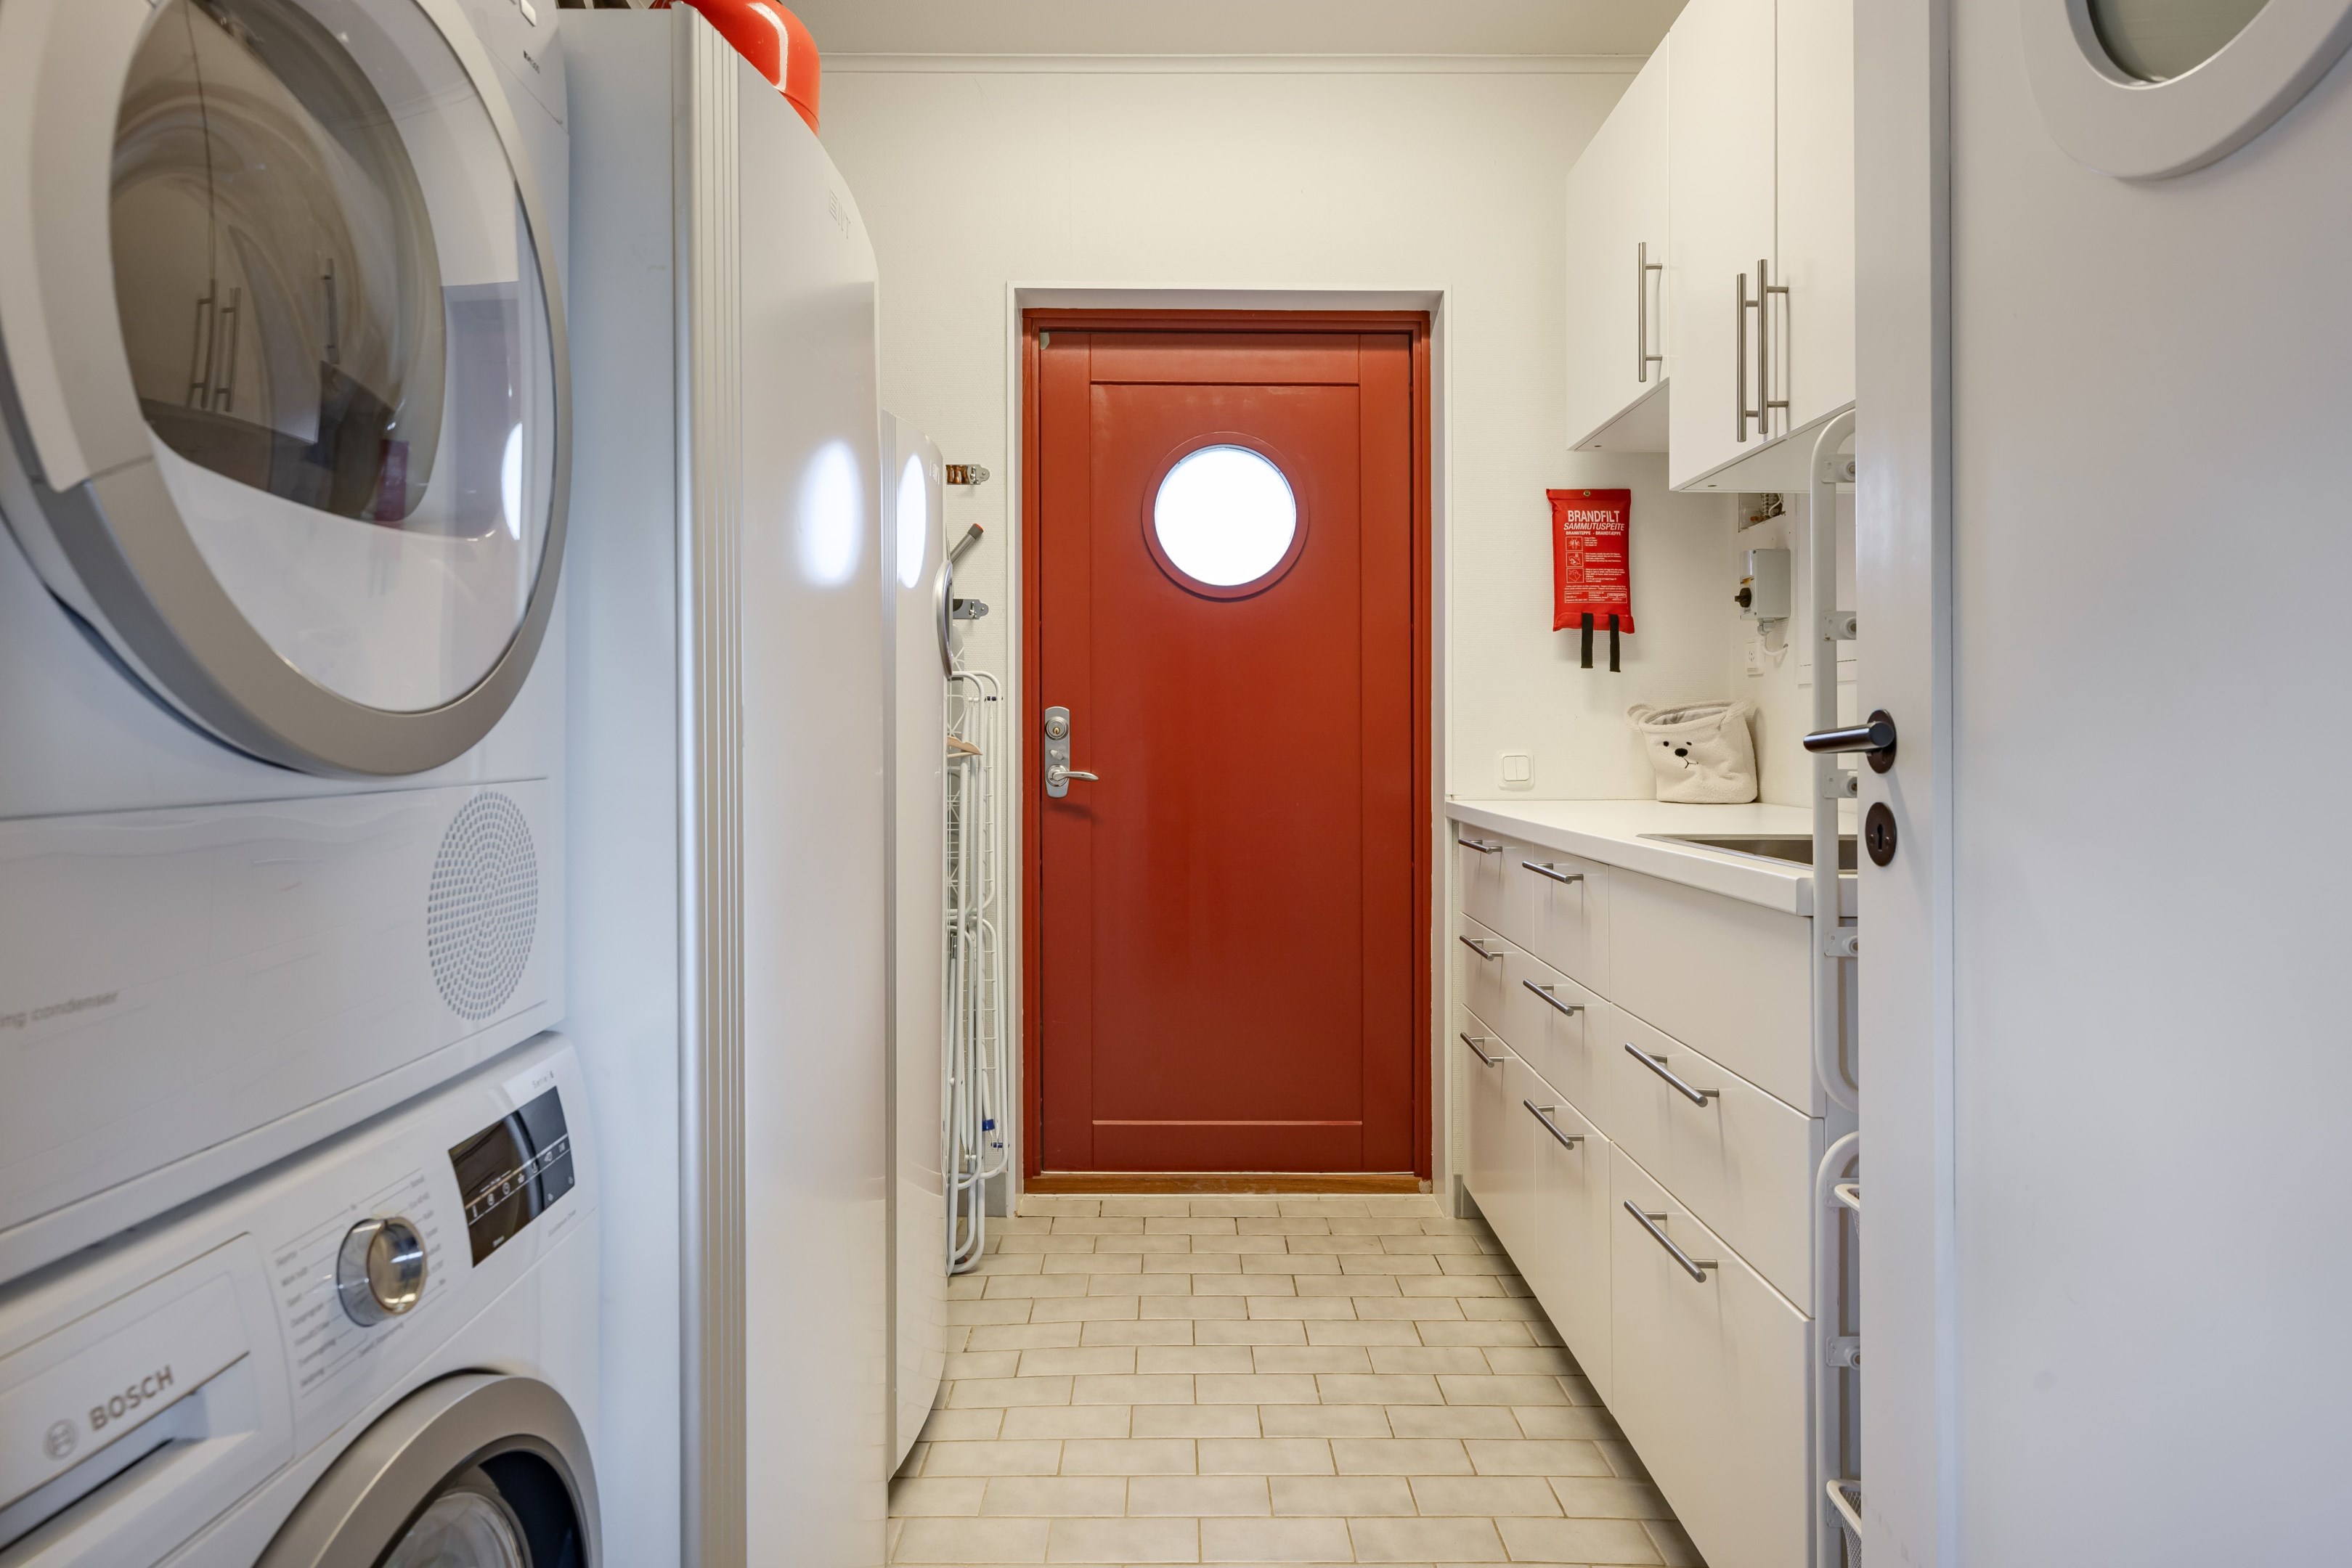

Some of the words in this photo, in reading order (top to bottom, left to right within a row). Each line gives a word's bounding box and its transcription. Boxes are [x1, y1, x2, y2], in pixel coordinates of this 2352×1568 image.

[1568, 510, 1620, 523] BRANDFILT
[1563, 523, 1625, 531] SAMMUTUSPEITE
[89, 1364, 174, 1432] BOSCH
